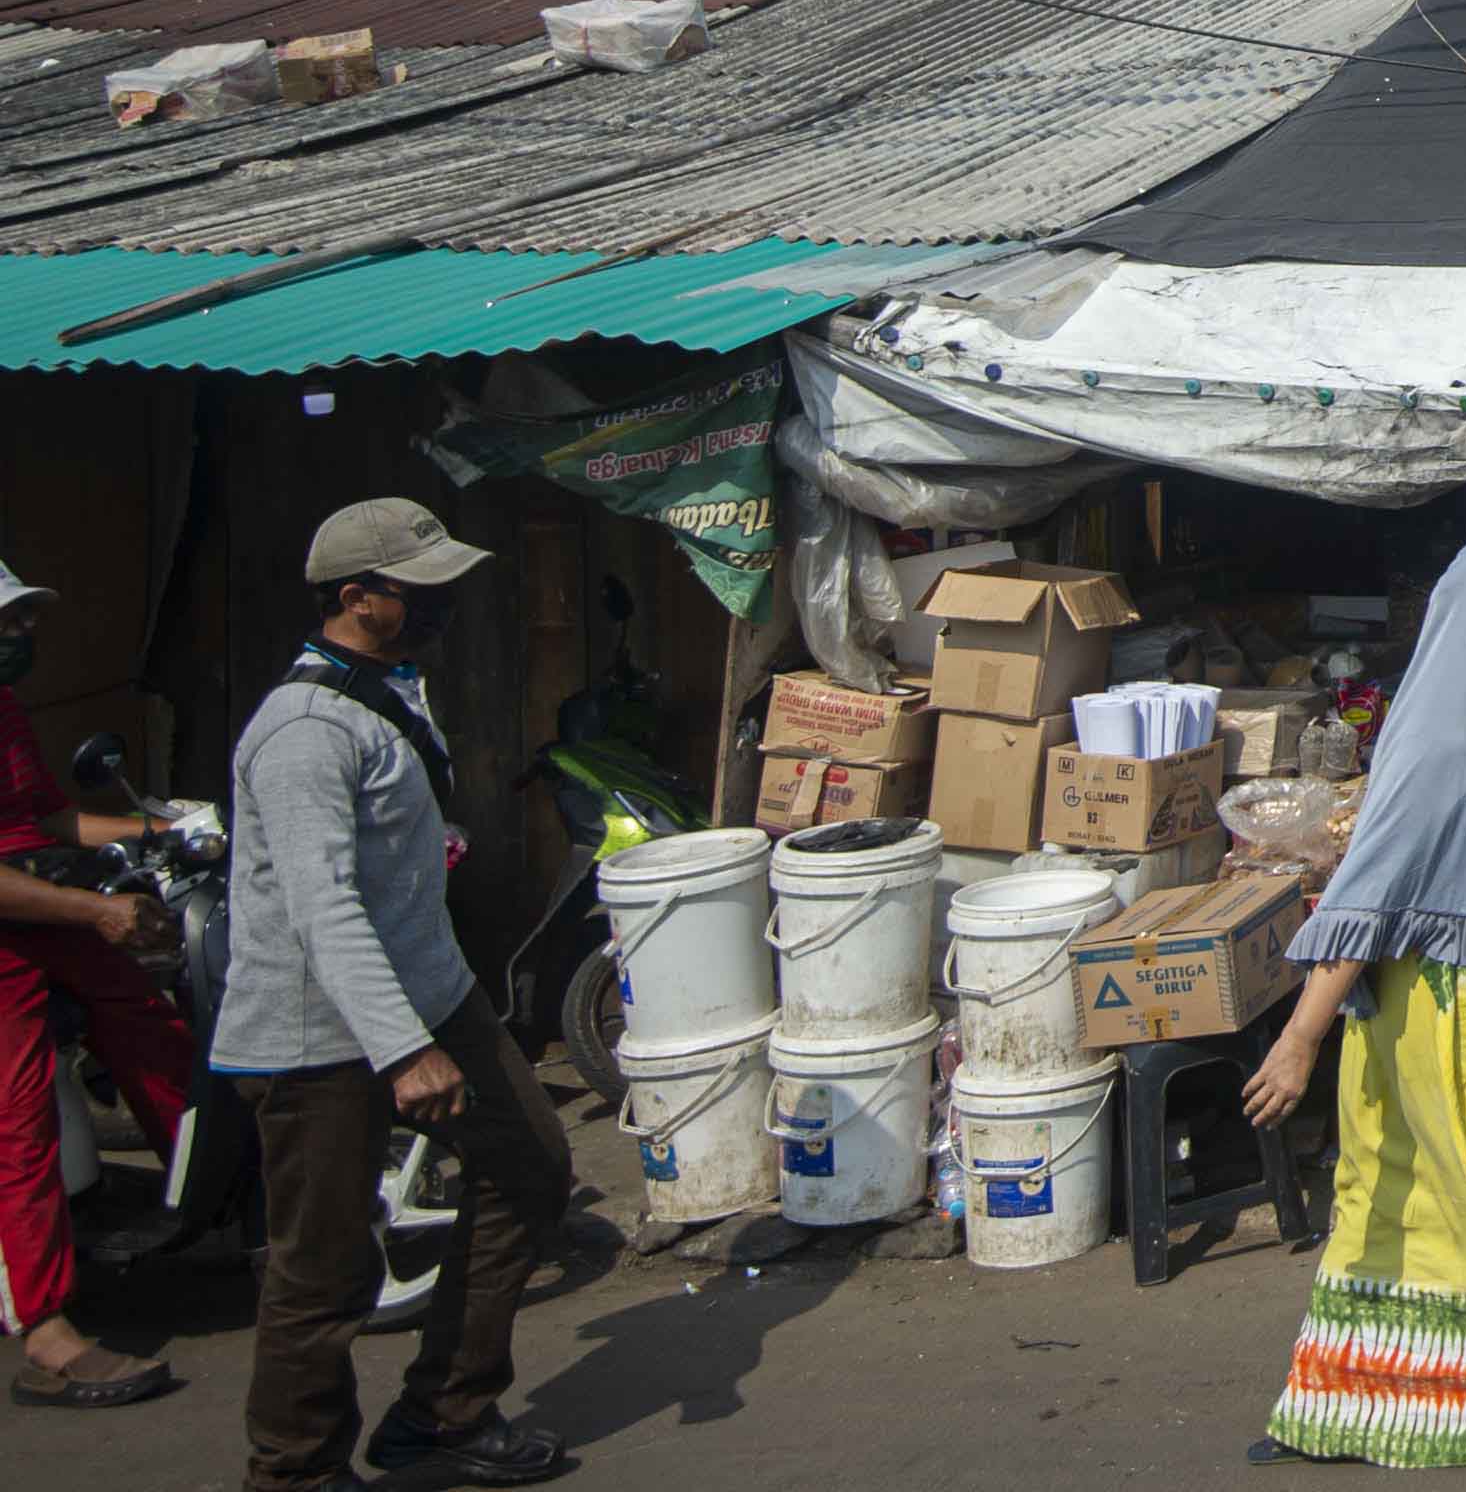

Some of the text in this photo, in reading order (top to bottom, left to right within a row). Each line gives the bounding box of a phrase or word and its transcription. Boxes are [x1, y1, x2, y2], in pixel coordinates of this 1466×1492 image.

[586, 436, 702, 482] Keluarga
[1135, 963, 1208, 984] SEGITIGA
[1154, 981, 1195, 996] BIRU
